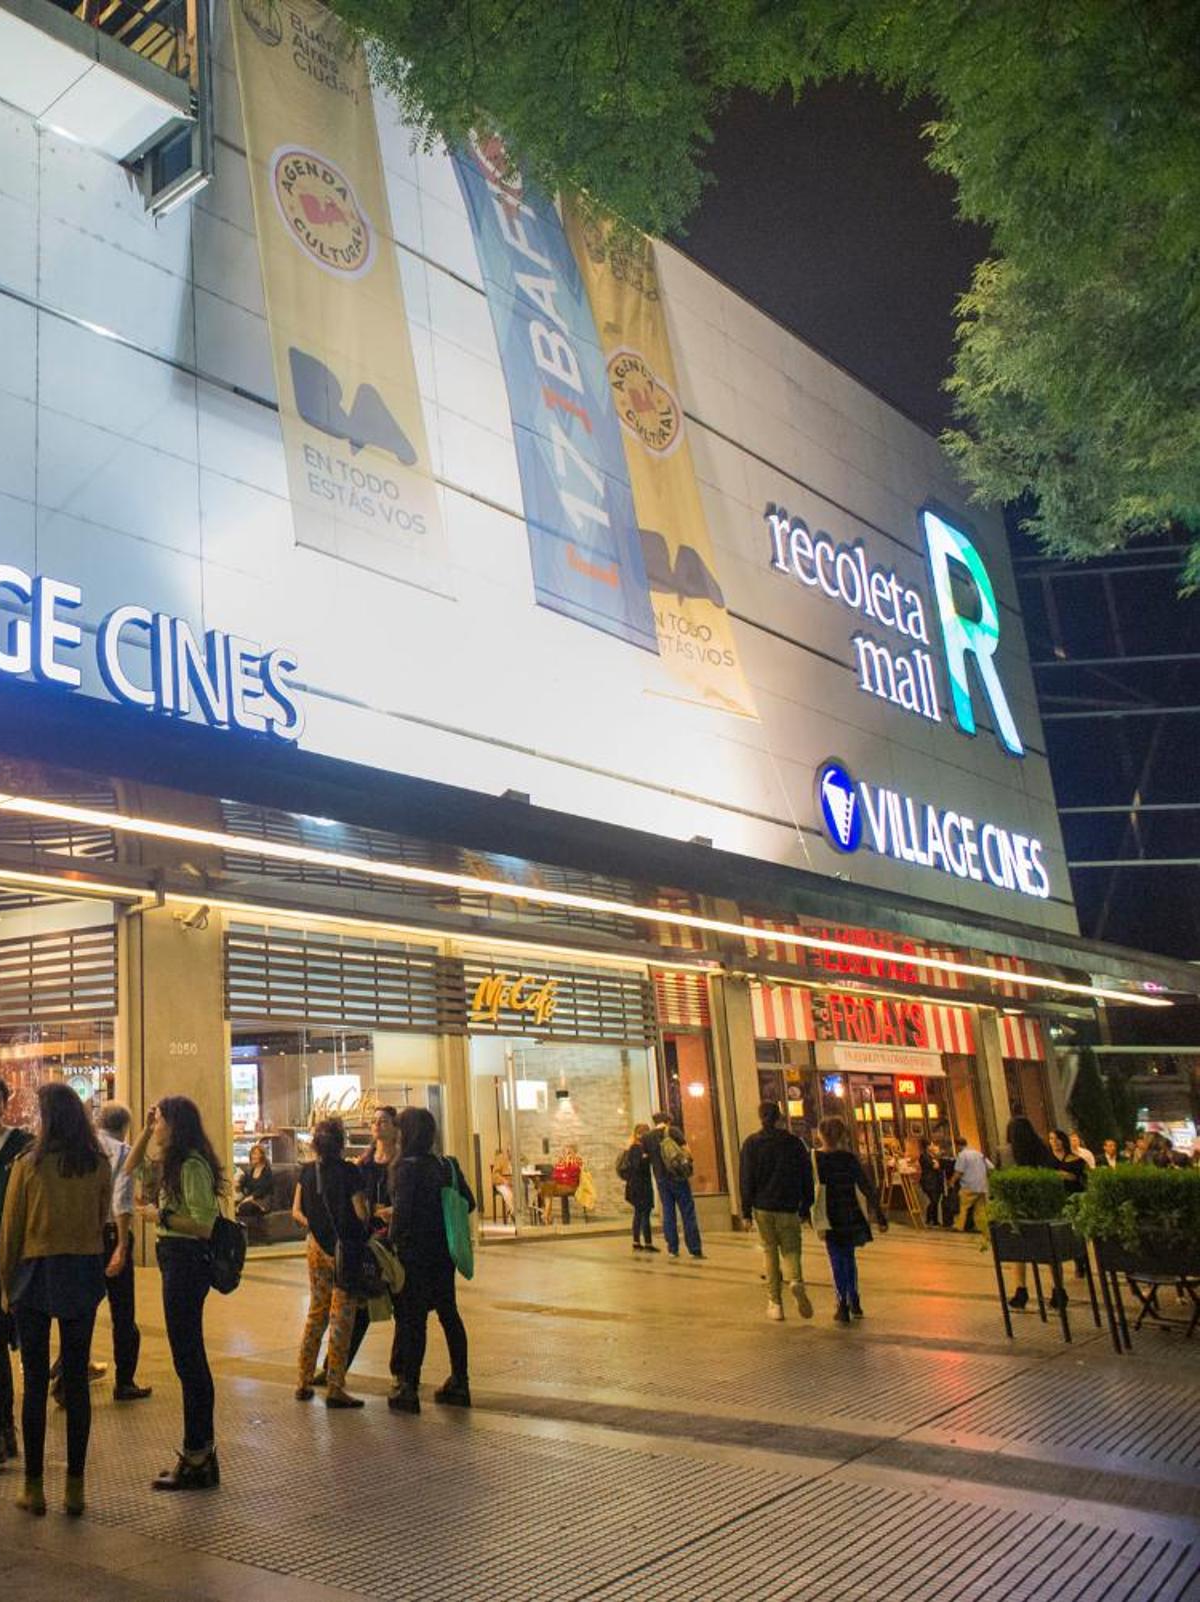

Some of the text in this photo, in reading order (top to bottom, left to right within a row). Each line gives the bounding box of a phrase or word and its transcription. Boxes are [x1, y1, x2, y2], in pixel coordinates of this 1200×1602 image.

[281, 160, 348, 202] AGENDA
[294, 217, 362, 263] CULTURAL
[303, 444, 400, 500] EN TODO
[379, 502, 426, 535] VOS
[766, 508, 931, 645] recoleta
[100, 604, 308, 743] CINES
[695, 645, 735, 667] VOS
[853, 635, 942, 722] mall
[859, 782, 1051, 898] VILLAGE CINES
